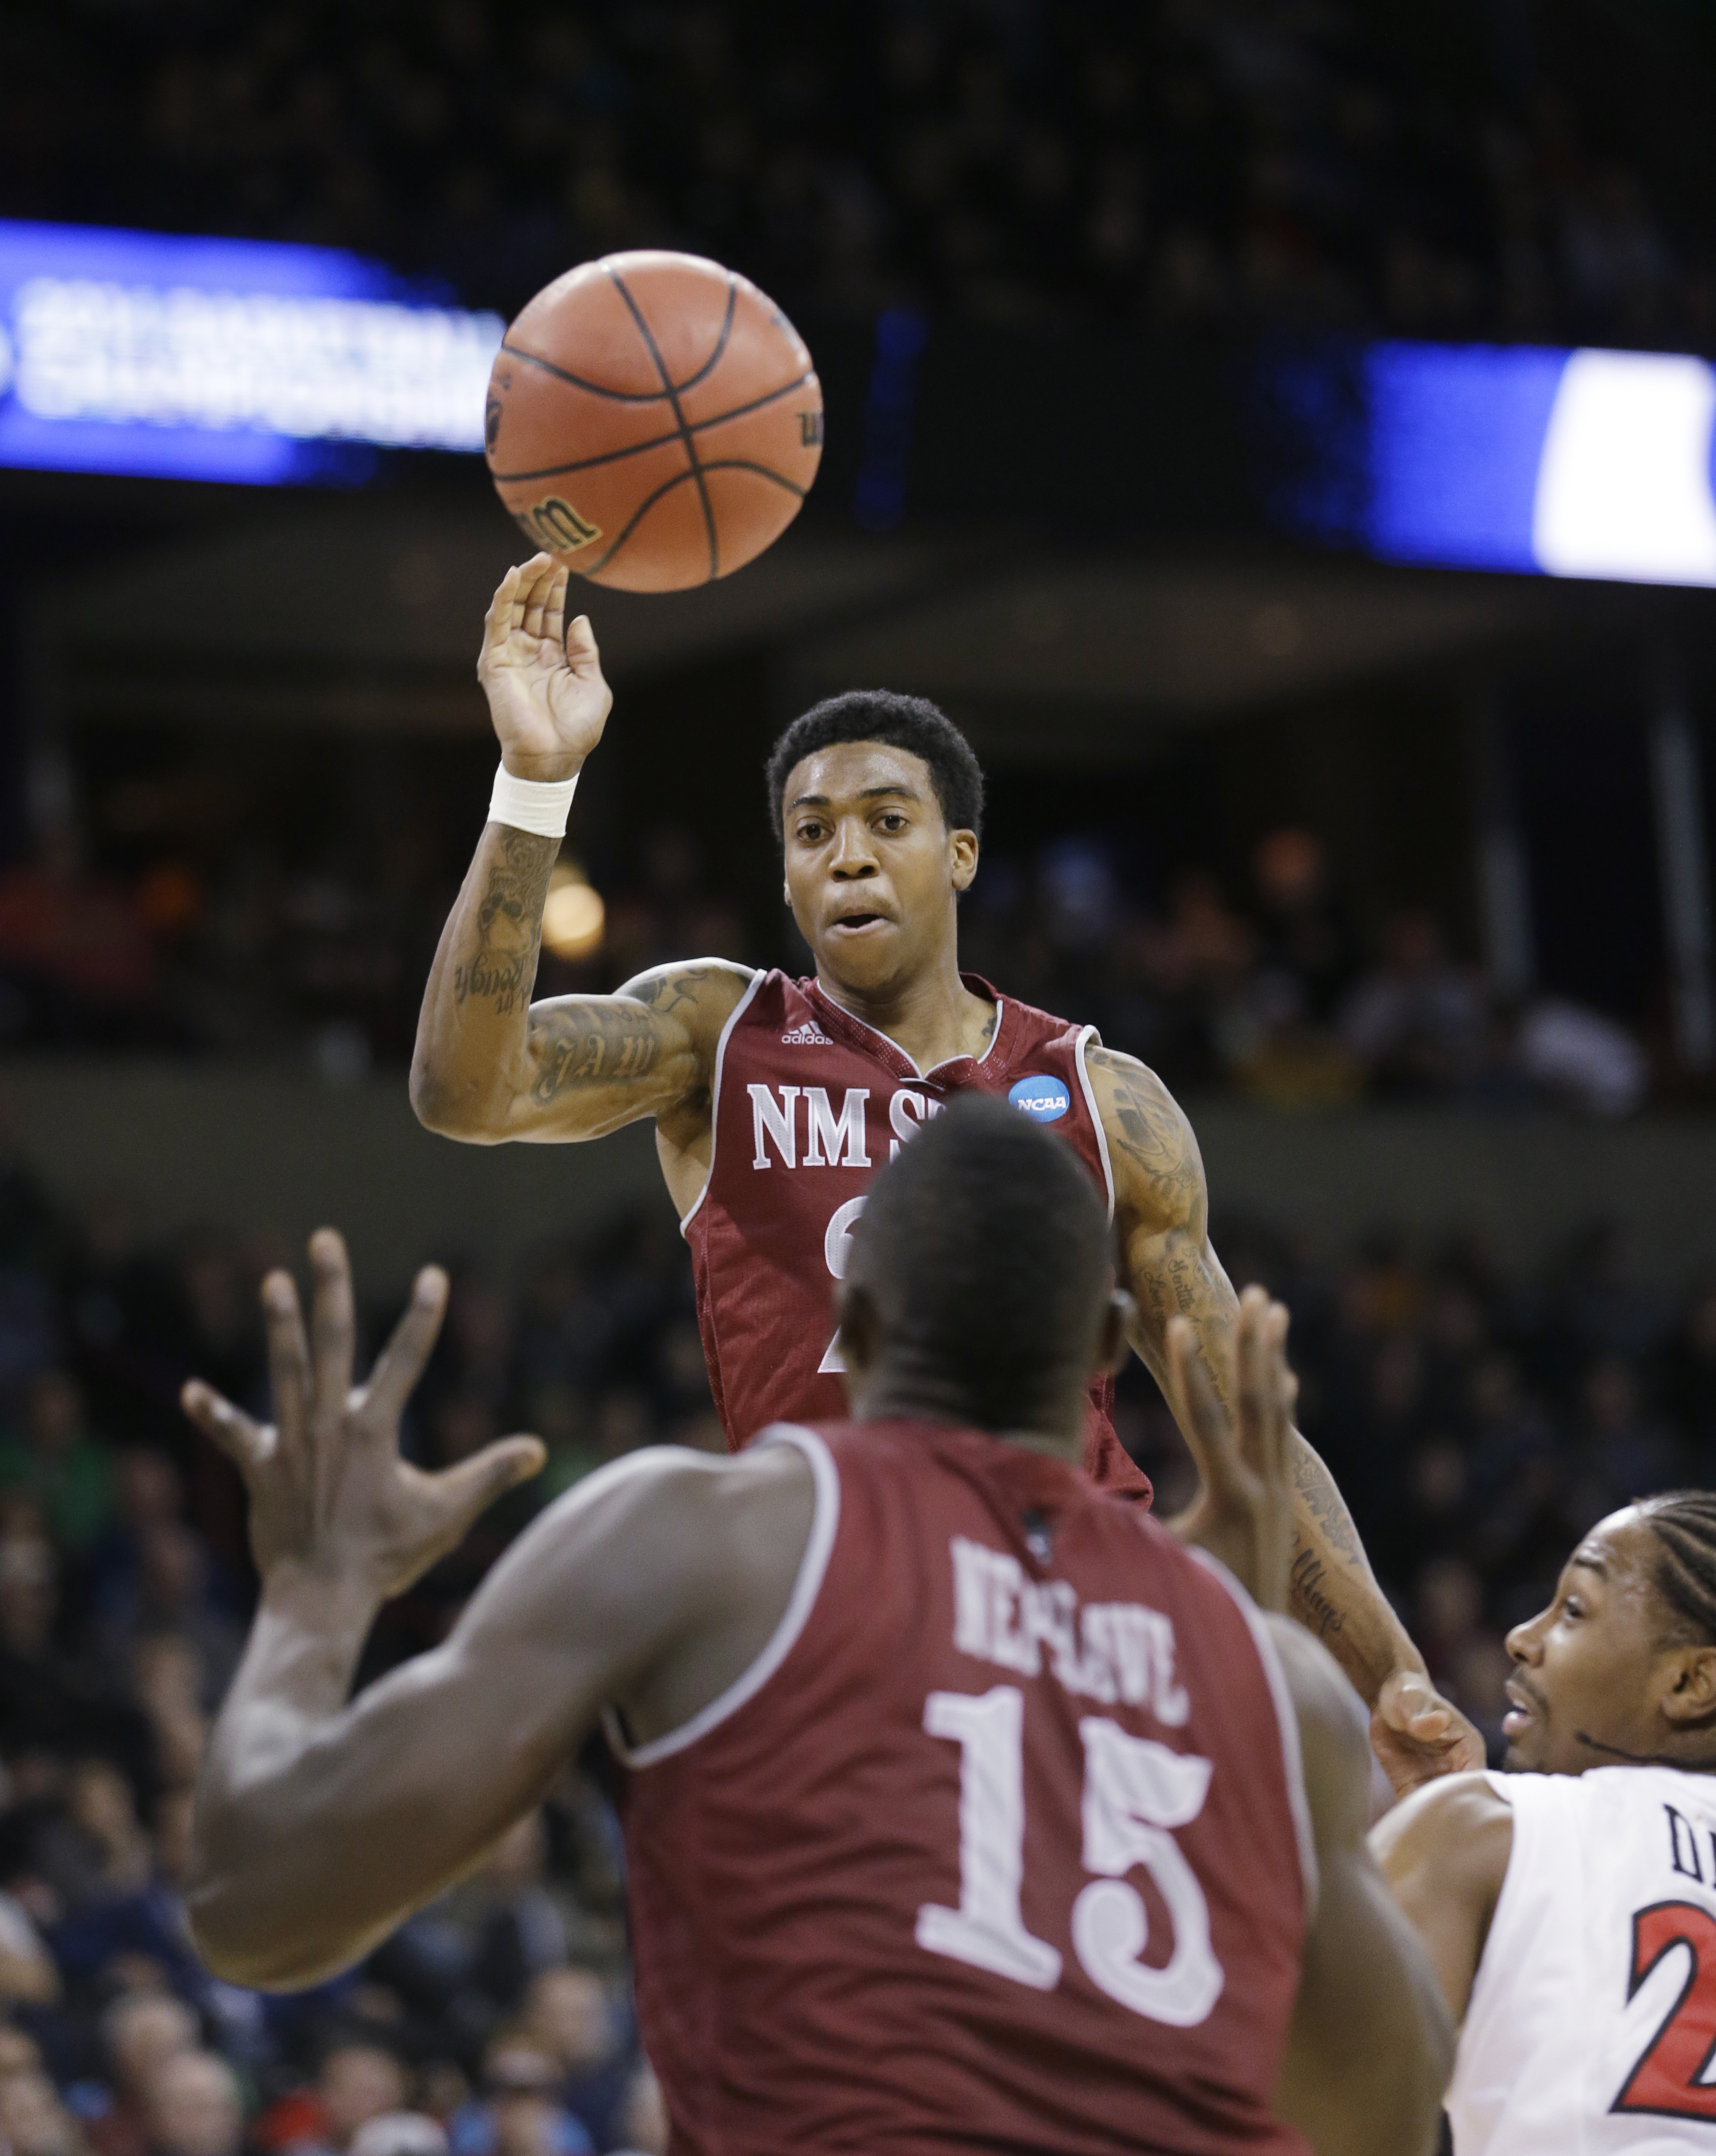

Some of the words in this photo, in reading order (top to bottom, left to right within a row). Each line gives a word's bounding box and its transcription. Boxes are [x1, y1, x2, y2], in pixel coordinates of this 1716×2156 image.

[781, 1033, 834, 1045] adidas
[747, 1083, 872, 1170] NM
[1018, 1096, 1067, 1112] NCAA
[915, 1684, 1226, 2028] 15
